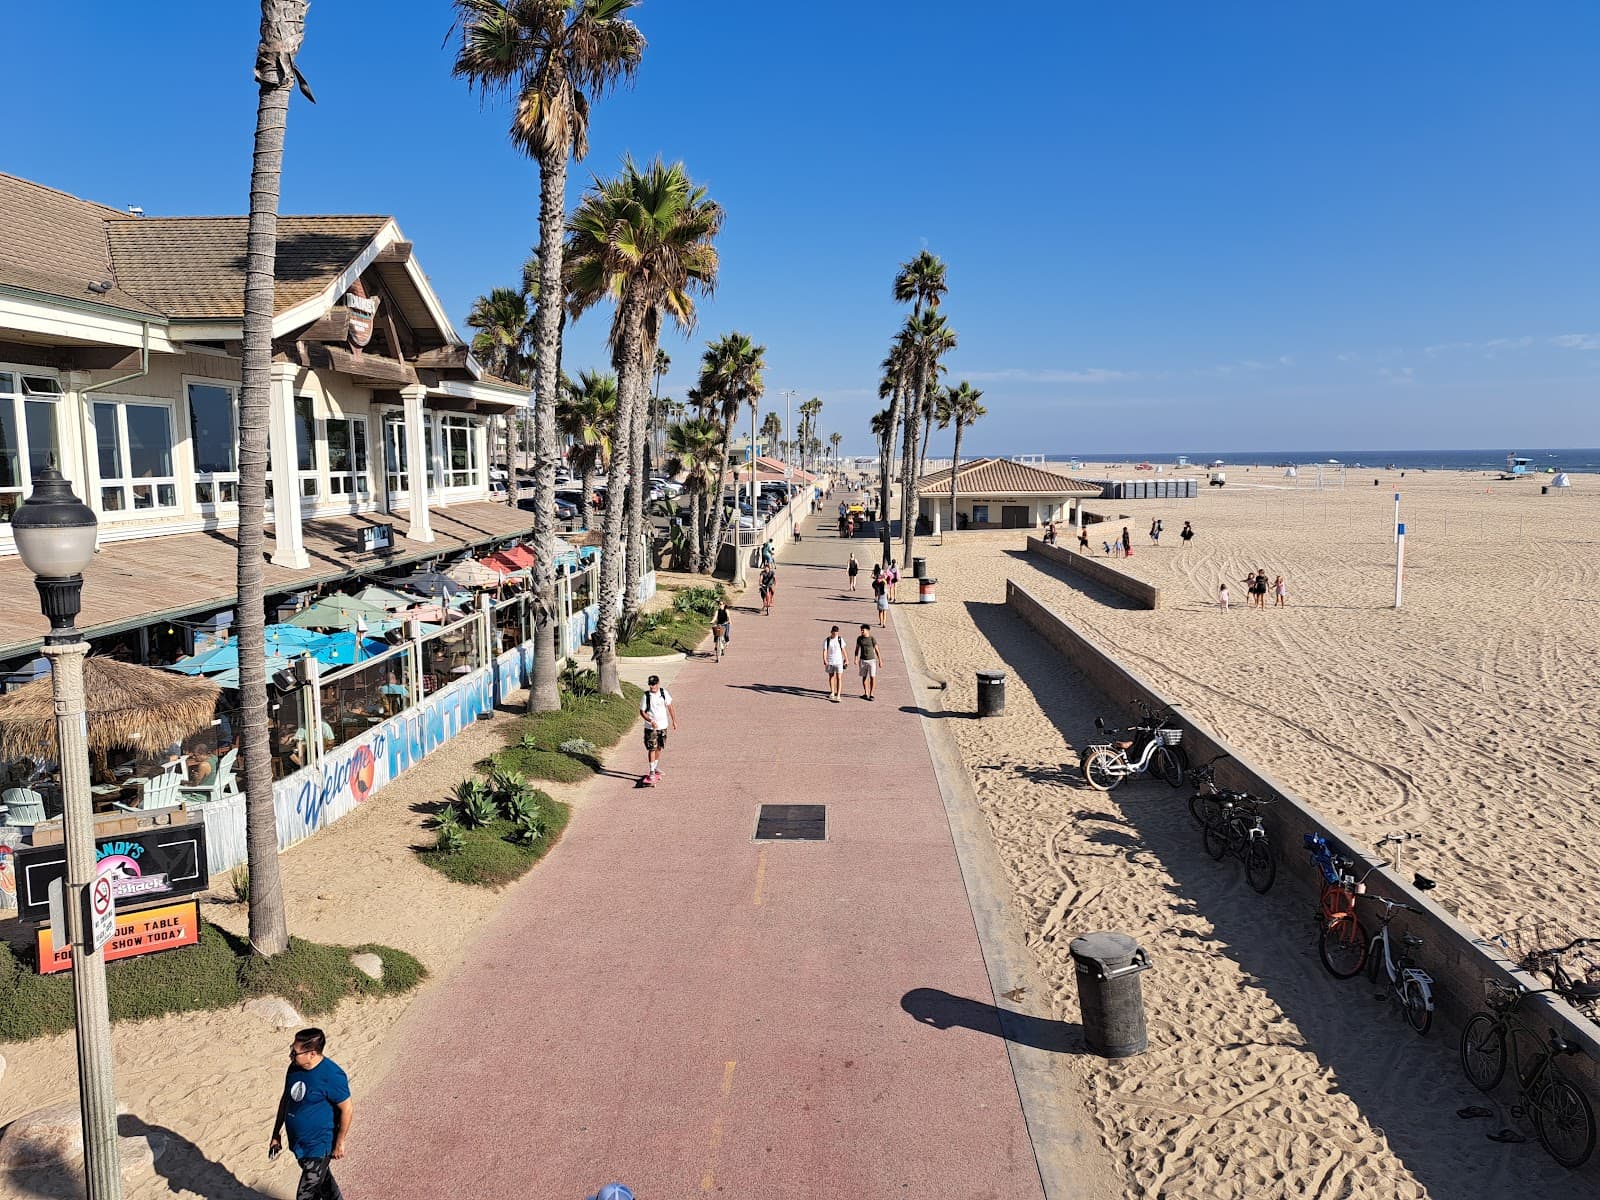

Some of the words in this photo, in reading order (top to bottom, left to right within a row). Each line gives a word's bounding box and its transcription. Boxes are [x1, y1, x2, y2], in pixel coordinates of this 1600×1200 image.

[296, 743, 371, 830] Welcome
[373, 732, 386, 762] to
[95, 841, 145, 861] ANDY'S
[114, 924, 135, 937] OUR
[143, 917, 179, 931] TABLE
[54, 950, 72, 962] FO
[111, 936, 143, 950] SHOW
[147, 927, 183, 943] TODAY
